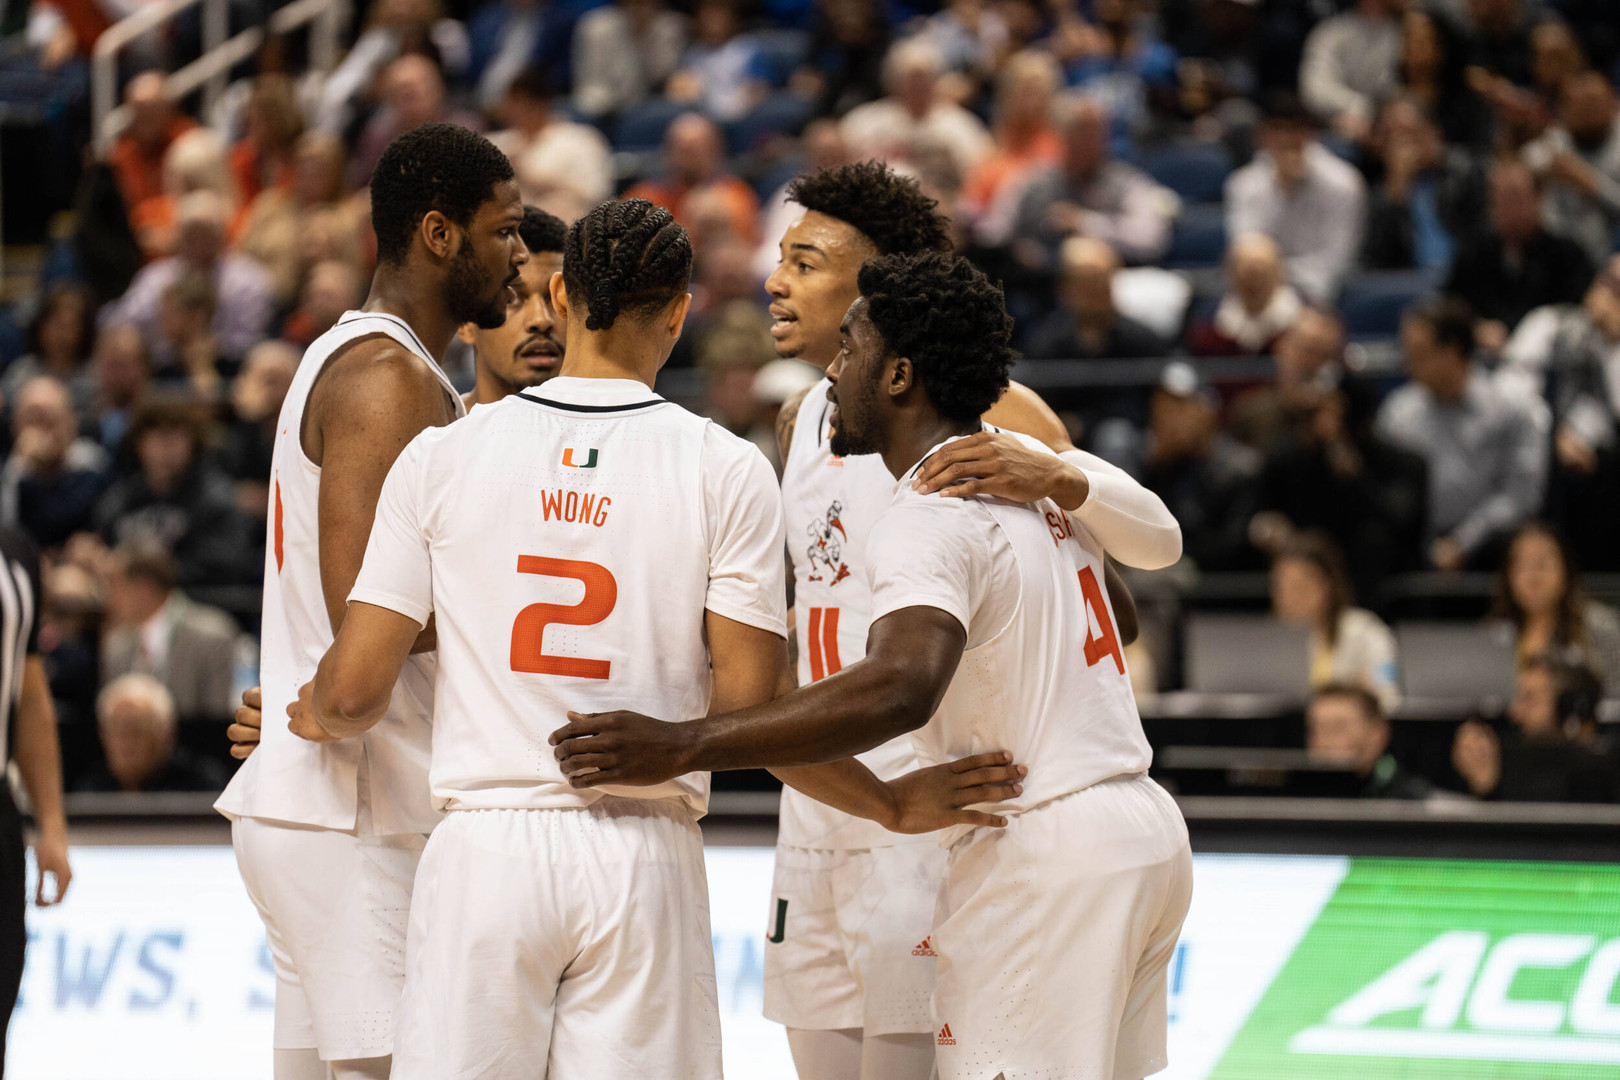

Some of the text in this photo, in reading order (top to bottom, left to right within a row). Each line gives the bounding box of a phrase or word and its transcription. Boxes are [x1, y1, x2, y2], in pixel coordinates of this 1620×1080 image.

[562, 447, 599, 468] U
[541, 488, 612, 528] WONG
[510, 554, 618, 680] 2
[808, 607, 842, 682] 11
[1077, 565, 1126, 676] 4
